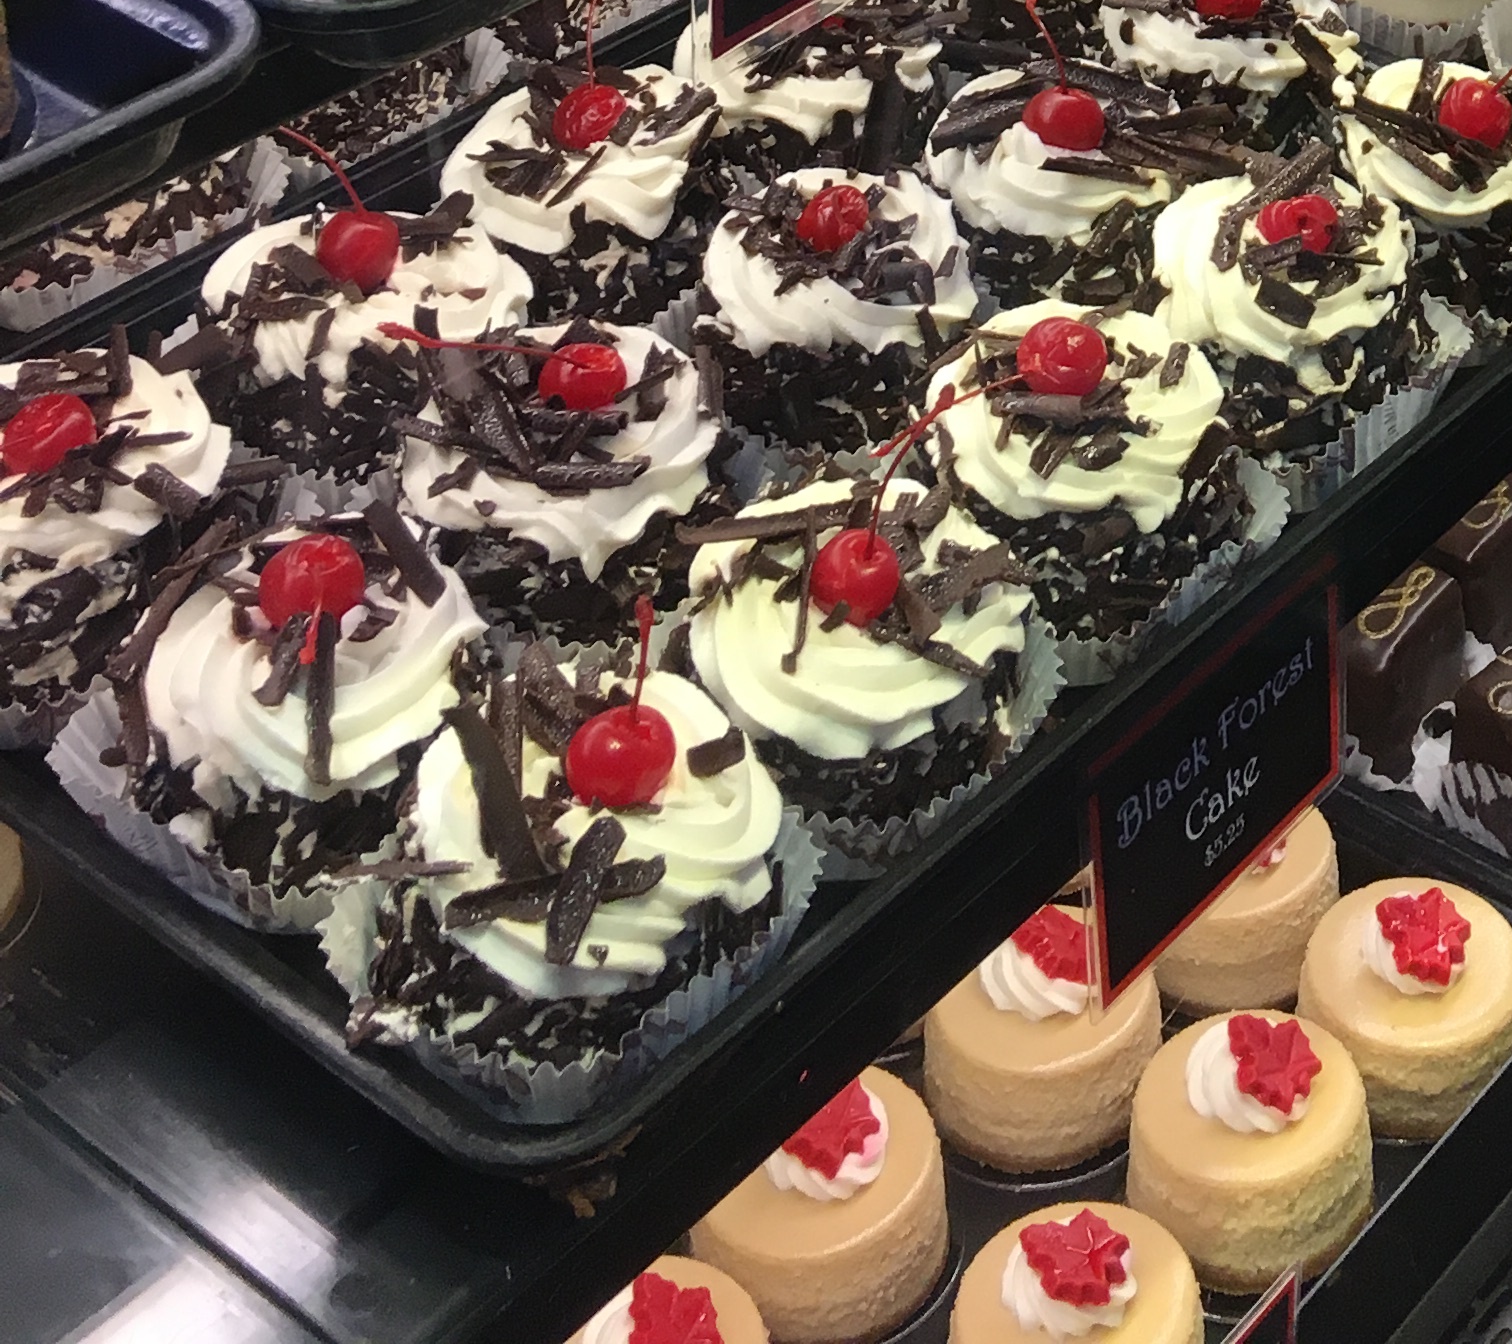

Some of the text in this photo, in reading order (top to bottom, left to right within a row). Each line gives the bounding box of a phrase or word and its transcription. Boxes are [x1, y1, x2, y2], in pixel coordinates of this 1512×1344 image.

[1116, 635, 1315, 850] Black Forest
[1184, 754, 1262, 842] Cake
[1203, 811, 1247, 868] $5.25
